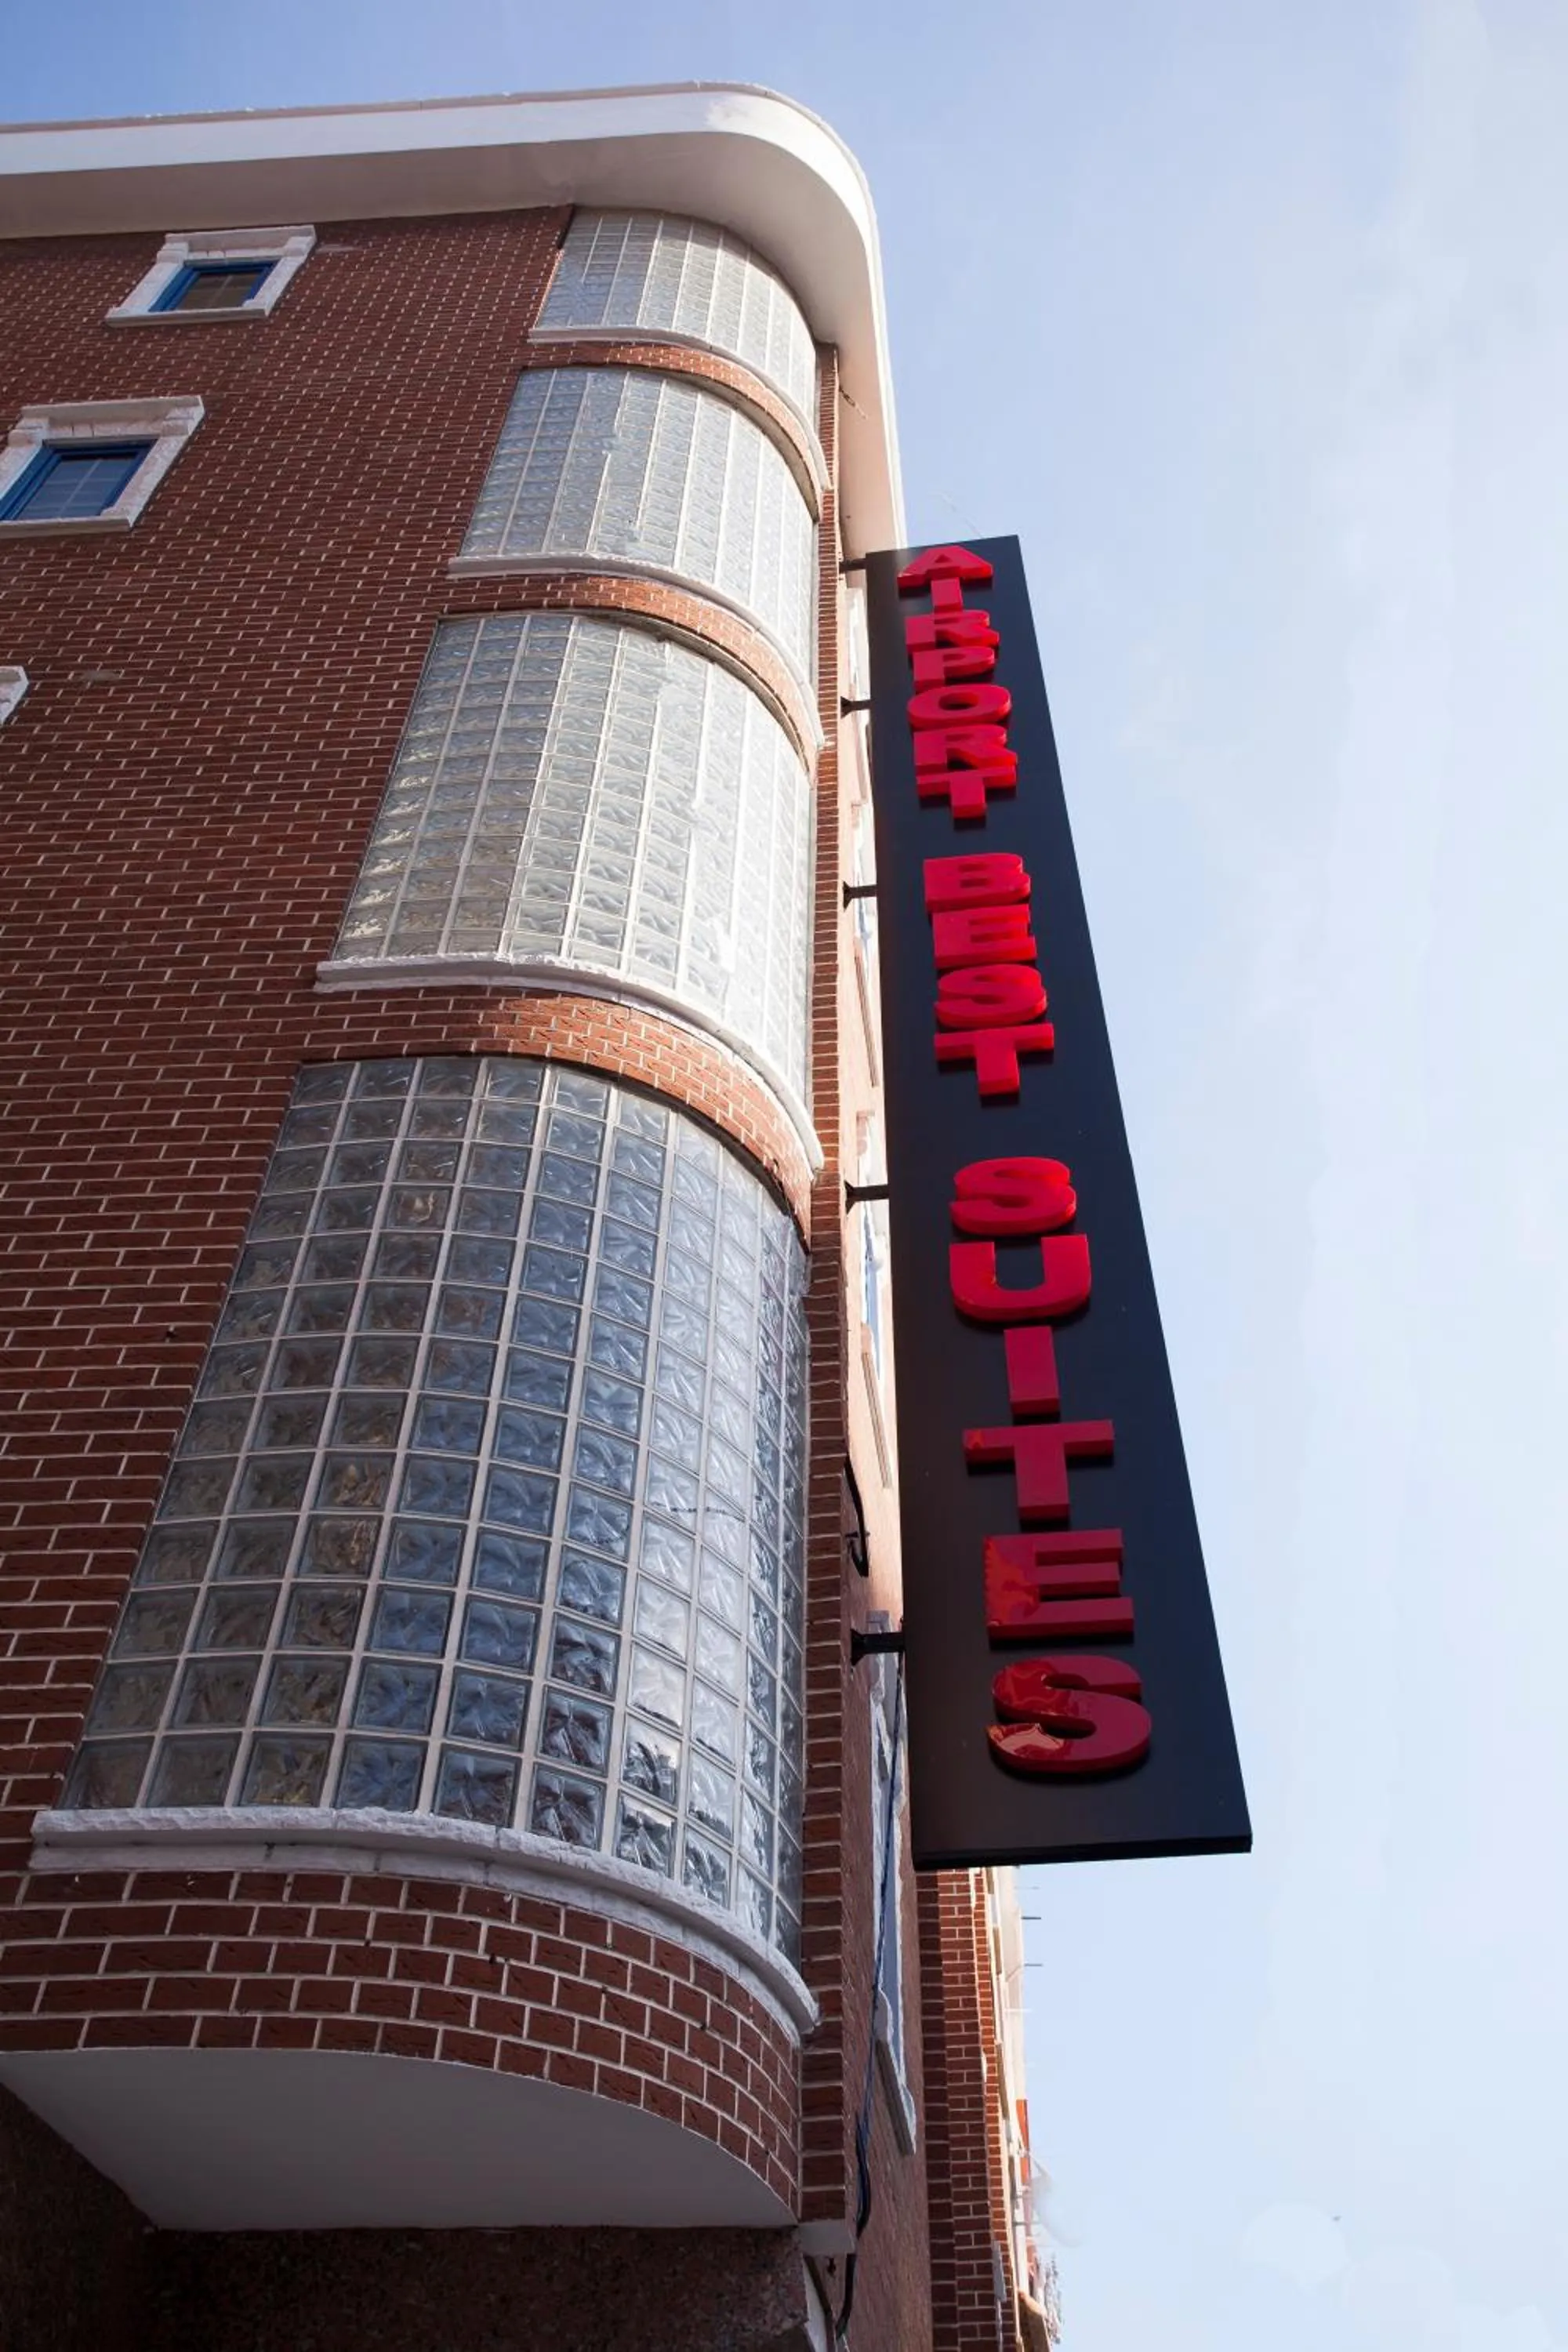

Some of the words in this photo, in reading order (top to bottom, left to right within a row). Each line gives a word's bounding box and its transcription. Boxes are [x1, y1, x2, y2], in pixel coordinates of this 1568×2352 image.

[897, 545, 1018, 819] AIRPORT
[924, 852, 1054, 1095] BEST
[949, 1156, 1152, 1773] SUITES
